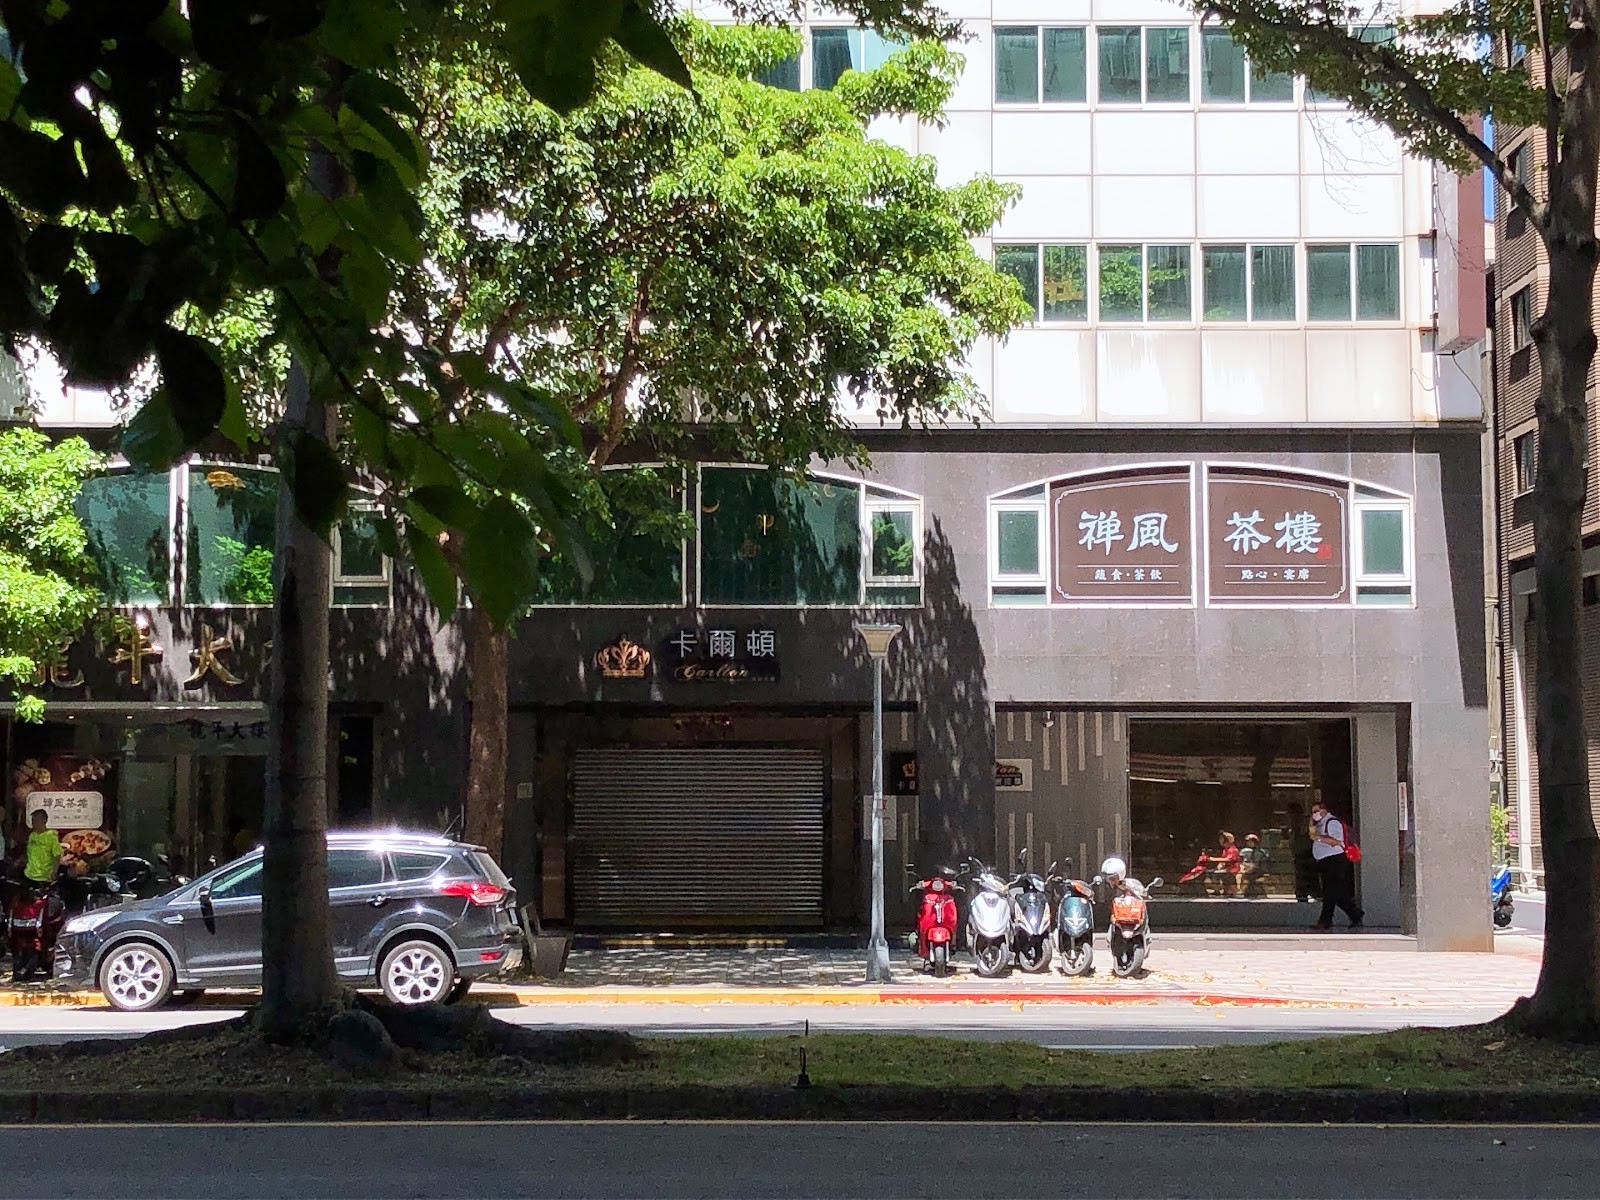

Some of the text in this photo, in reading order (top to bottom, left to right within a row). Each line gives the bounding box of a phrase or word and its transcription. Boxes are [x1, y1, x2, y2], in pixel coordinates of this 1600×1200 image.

[1223, 510, 1323, 555] 茶樓
[670, 629, 775, 658] 卡爾頓
